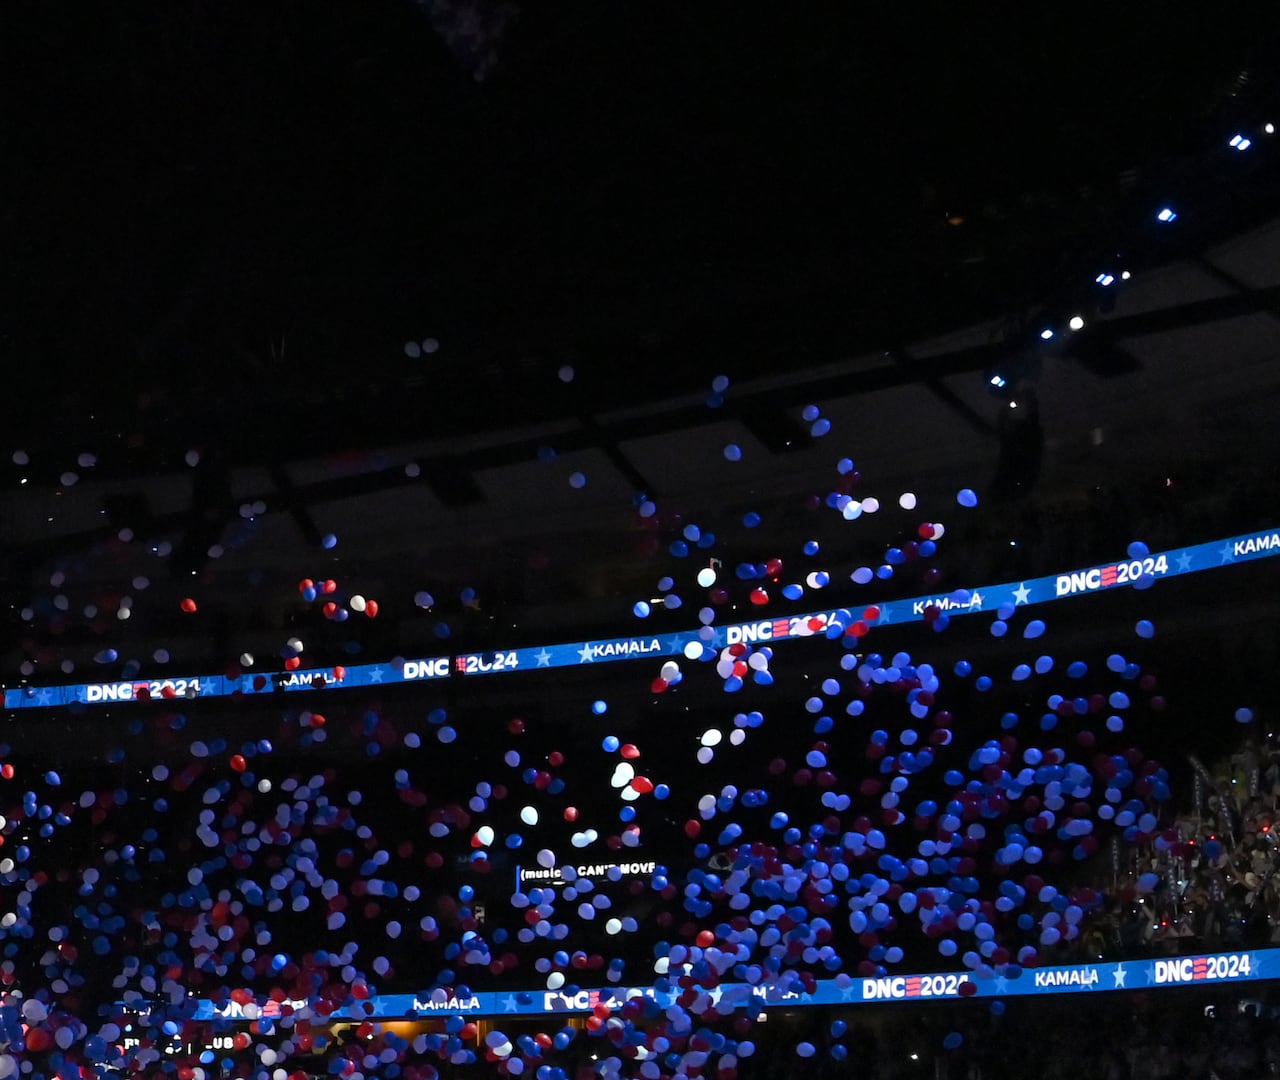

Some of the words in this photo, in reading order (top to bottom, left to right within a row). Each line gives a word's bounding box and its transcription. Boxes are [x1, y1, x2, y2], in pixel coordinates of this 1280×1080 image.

[87, 683, 134, 702] DNC
[403, 658, 449, 680] DNC
[593, 636, 661, 657] KAMALA
[727, 621, 773, 645] DNC
[1056, 568, 1101, 596] DNC
[1117, 556, 1168, 583] 2024
[863, 977, 905, 1000] DNC
[1035, 968, 1099, 987] KAMALA
[1155, 960, 1193, 983] DNC
[1207, 955, 1251, 979] 2024
